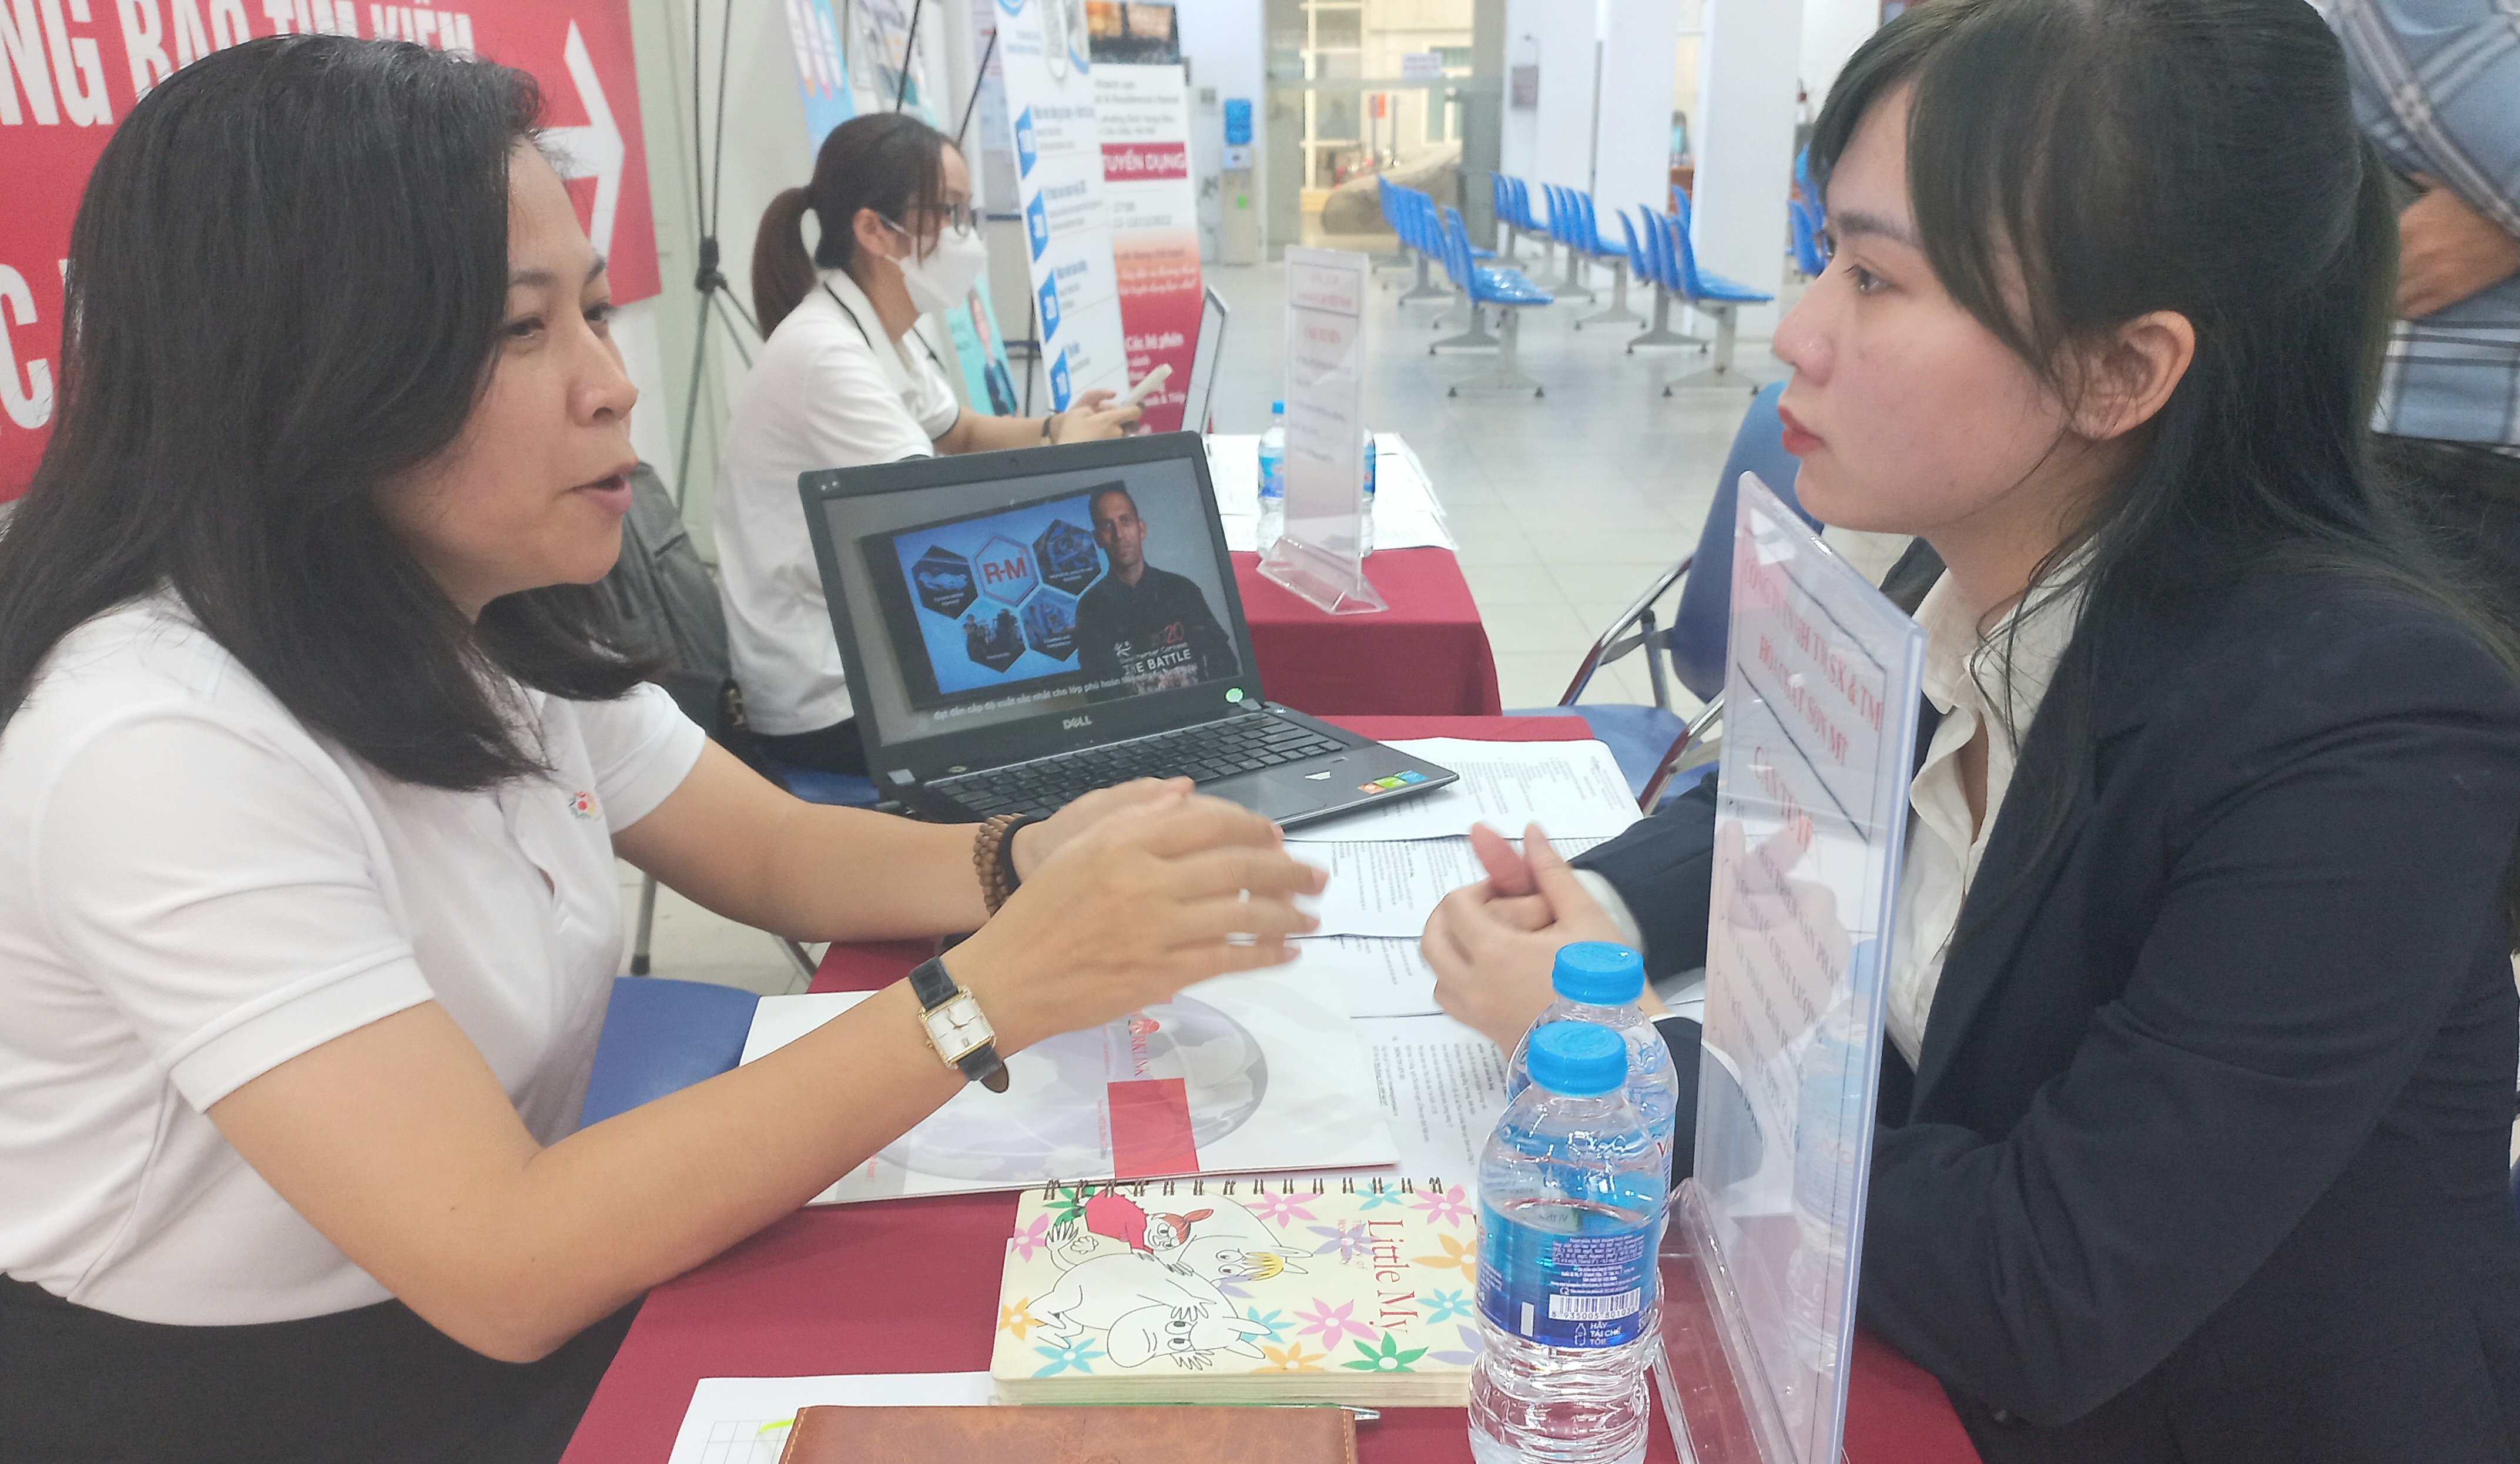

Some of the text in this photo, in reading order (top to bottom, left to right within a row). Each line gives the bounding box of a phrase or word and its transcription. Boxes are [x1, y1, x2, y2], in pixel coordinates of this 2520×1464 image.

[983, 557, 1028, 584] R-M
[1147, 649, 1191, 670] BATTLE
[1062, 715, 1092, 730] DELL
[1368, 1220, 1418, 1334] Little My
